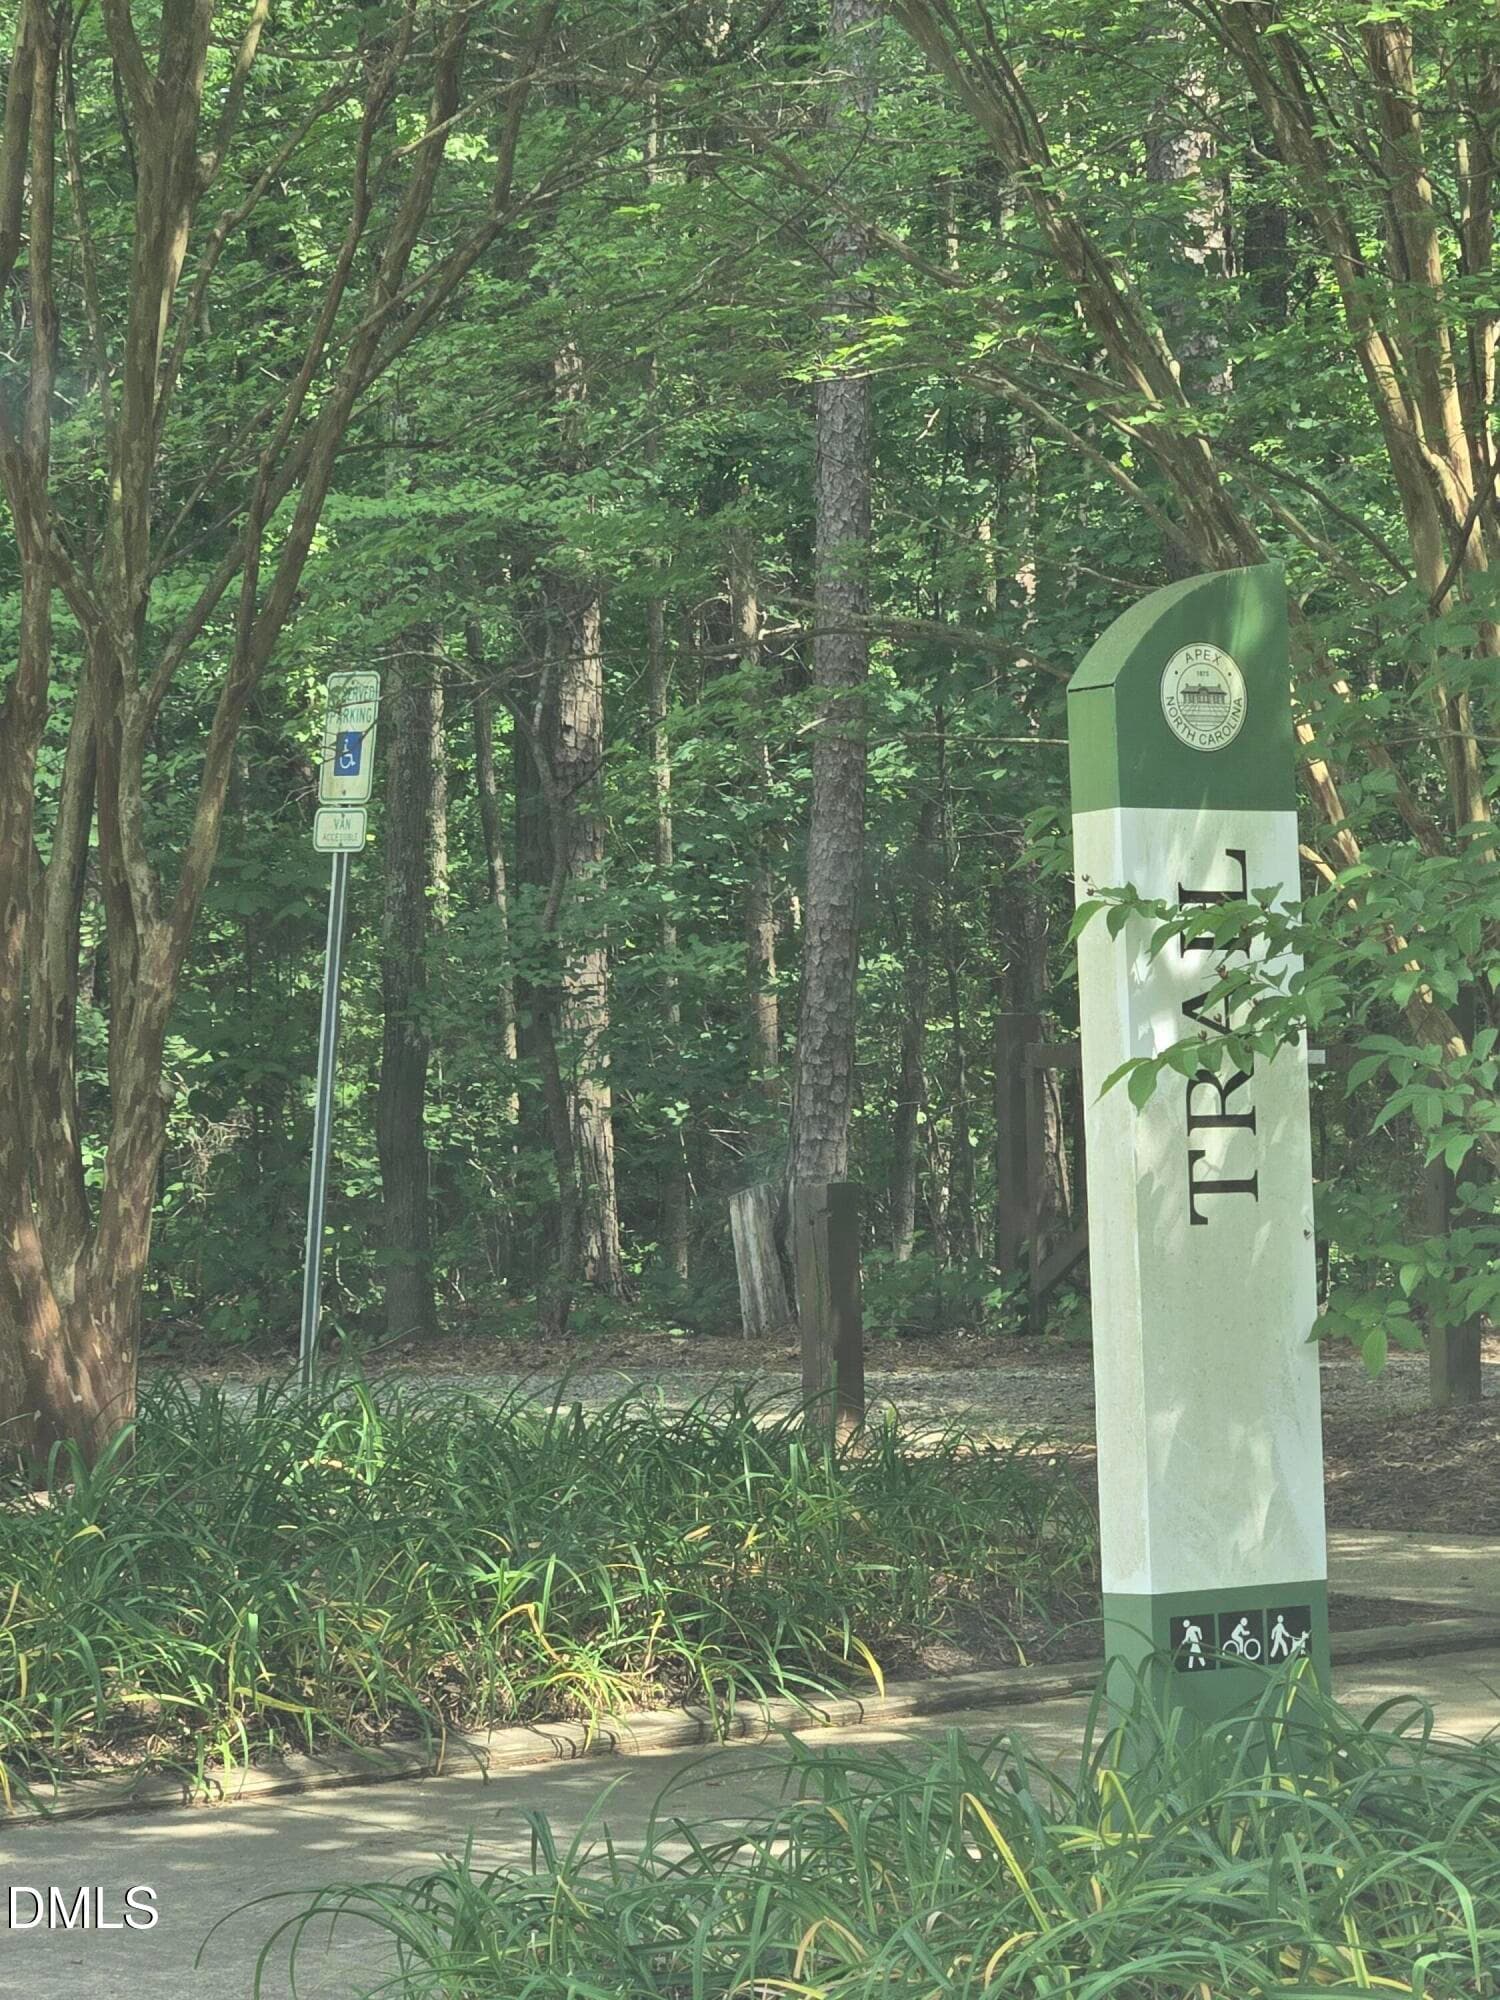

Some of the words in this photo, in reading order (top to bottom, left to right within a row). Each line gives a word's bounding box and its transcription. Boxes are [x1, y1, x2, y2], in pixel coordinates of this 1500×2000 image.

[1185, 648, 1223, 666] APEX
[1165, 696, 1196, 741] NORTH
[1198, 697, 1243, 745] CAROLINA
[333, 818, 351, 831] VAN
